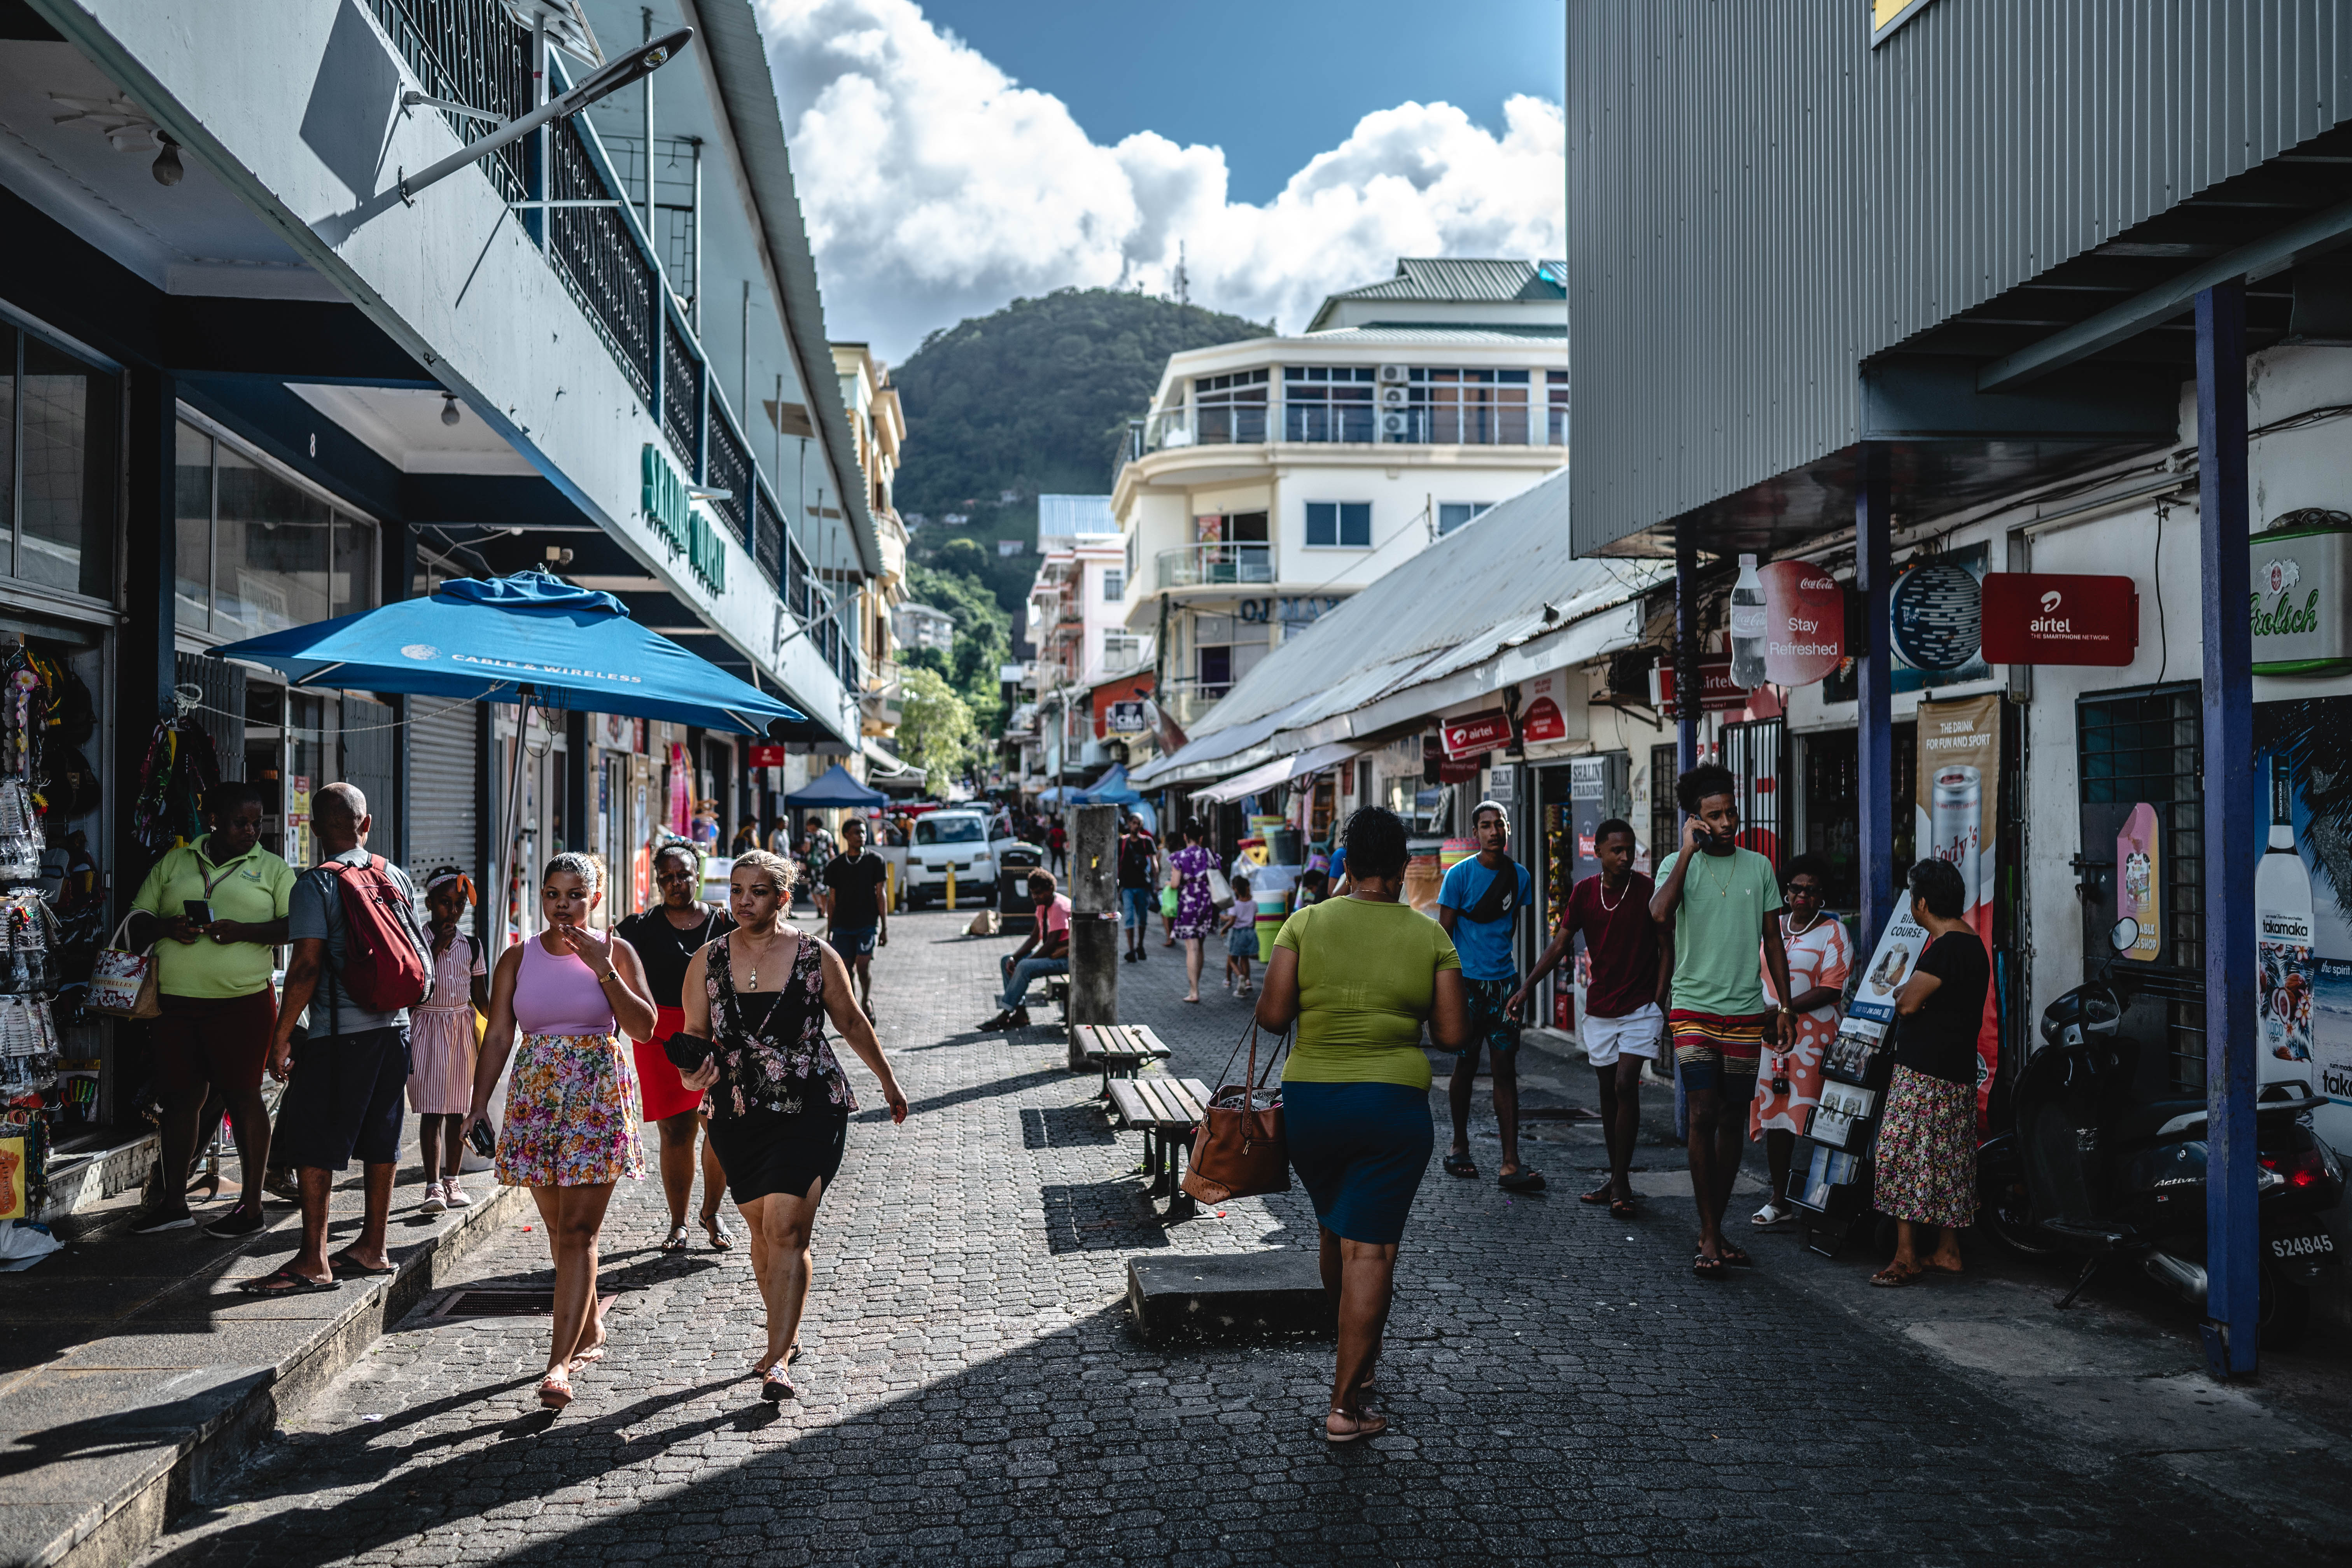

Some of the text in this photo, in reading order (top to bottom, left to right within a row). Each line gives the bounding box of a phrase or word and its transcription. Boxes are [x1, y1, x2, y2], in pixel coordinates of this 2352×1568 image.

[310, 432, 316, 458] 8
[1801, 577, 1833, 590] Coca-Cola
[1788, 617, 1818, 634] Stay
[2030, 616, 2071, 633] airtel
[1770, 642, 1837, 655] Refreshed
[451, 654, 517, 668] CABLE
[543, 665, 642, 683] WIRELESS
[1703, 675, 1732, 689] irtel
[1469, 724, 1493, 740] airtel
[1940, 720, 1974, 735] THE DRINK
[1926, 733, 1991, 750] FOR FUN AND SPORT
[1934, 825, 1977, 868] Cody's
[1900, 914, 1916, 924] BIB
[1891, 926, 1924, 938] COURSE
[2263, 919, 2308, 937] takamaka
[2140, 938, 2157, 950] SHOP
[2321, 959, 2351, 976] the spirit
[94, 979, 133, 988] SEYCHELLES
[1867, 1007, 1883, 1016] JW.ORG
[2266, 1021, 2283, 1037] COCO
[2154, 1177, 2197, 1187] Activa
[2272, 1234, 2333, 1257] S24845
